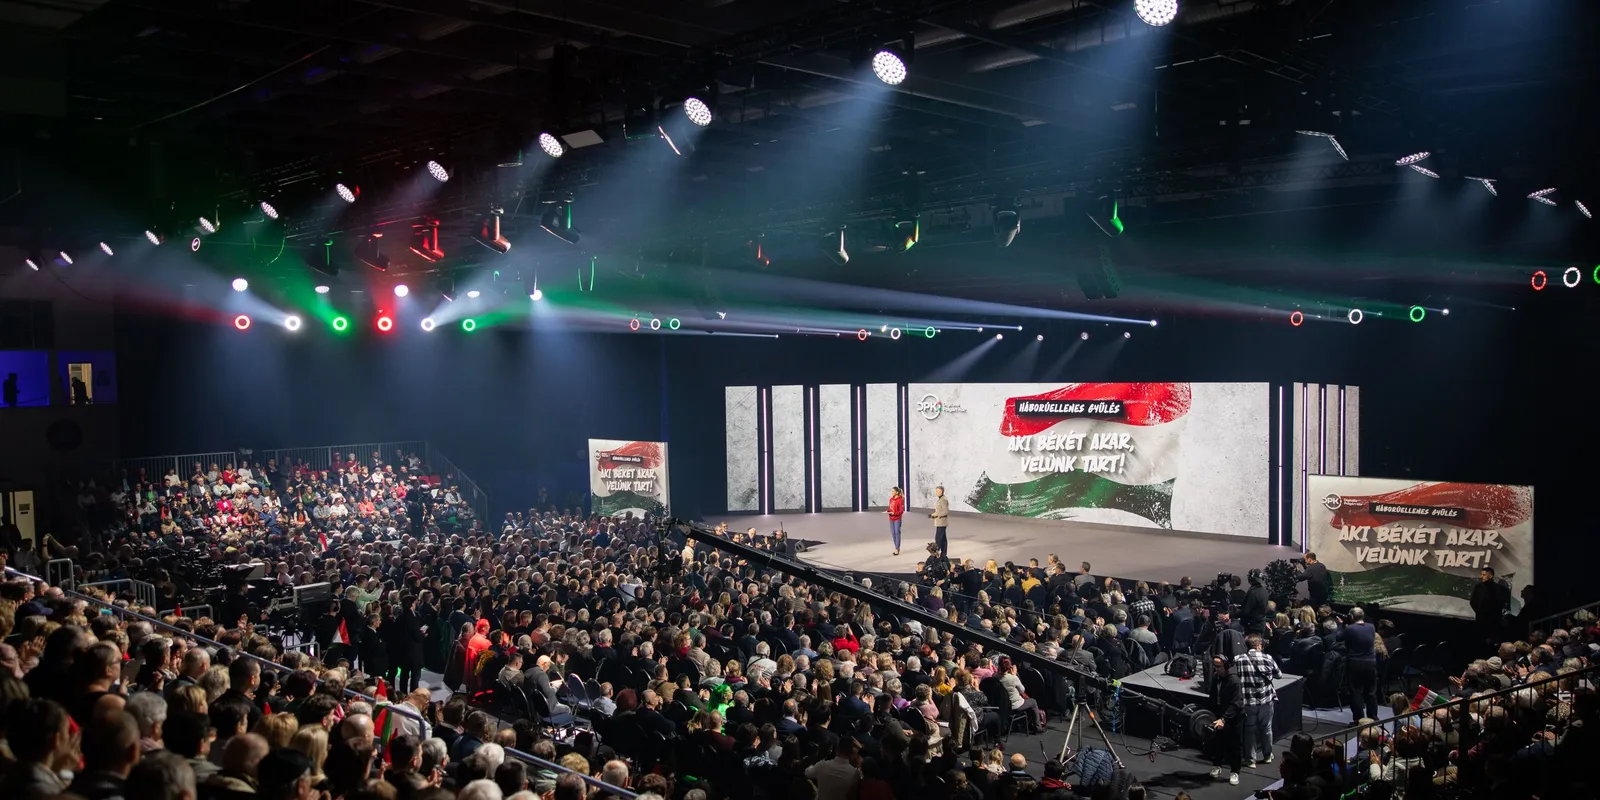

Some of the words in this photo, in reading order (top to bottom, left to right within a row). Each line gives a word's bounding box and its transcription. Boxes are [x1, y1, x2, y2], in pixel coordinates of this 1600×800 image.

[1019, 401, 1085, 413] HÁBORÚELLENES
[1007, 435, 1031, 452] AKI
[1037, 430, 1087, 451] BÉKÉT
[1089, 432, 1135, 453] AKAR,
[1020, 453, 1077, 473] VELÜNK
[1081, 453, 1126, 474] TART!
[600, 468, 612, 479] AKI
[636, 468, 657, 480] AKAR,
[633, 480, 653, 493] TART!
[1375, 505, 1430, 516] HÁBORÚELLENES
[1338, 525, 1371, 543] AKI
[1376, 523, 1442, 545] BÉKÉT
[1446, 529, 1504, 550] AKAR,
[1355, 546, 1430, 566] VELÜNK
[1435, 549, 1492, 569] TART!
